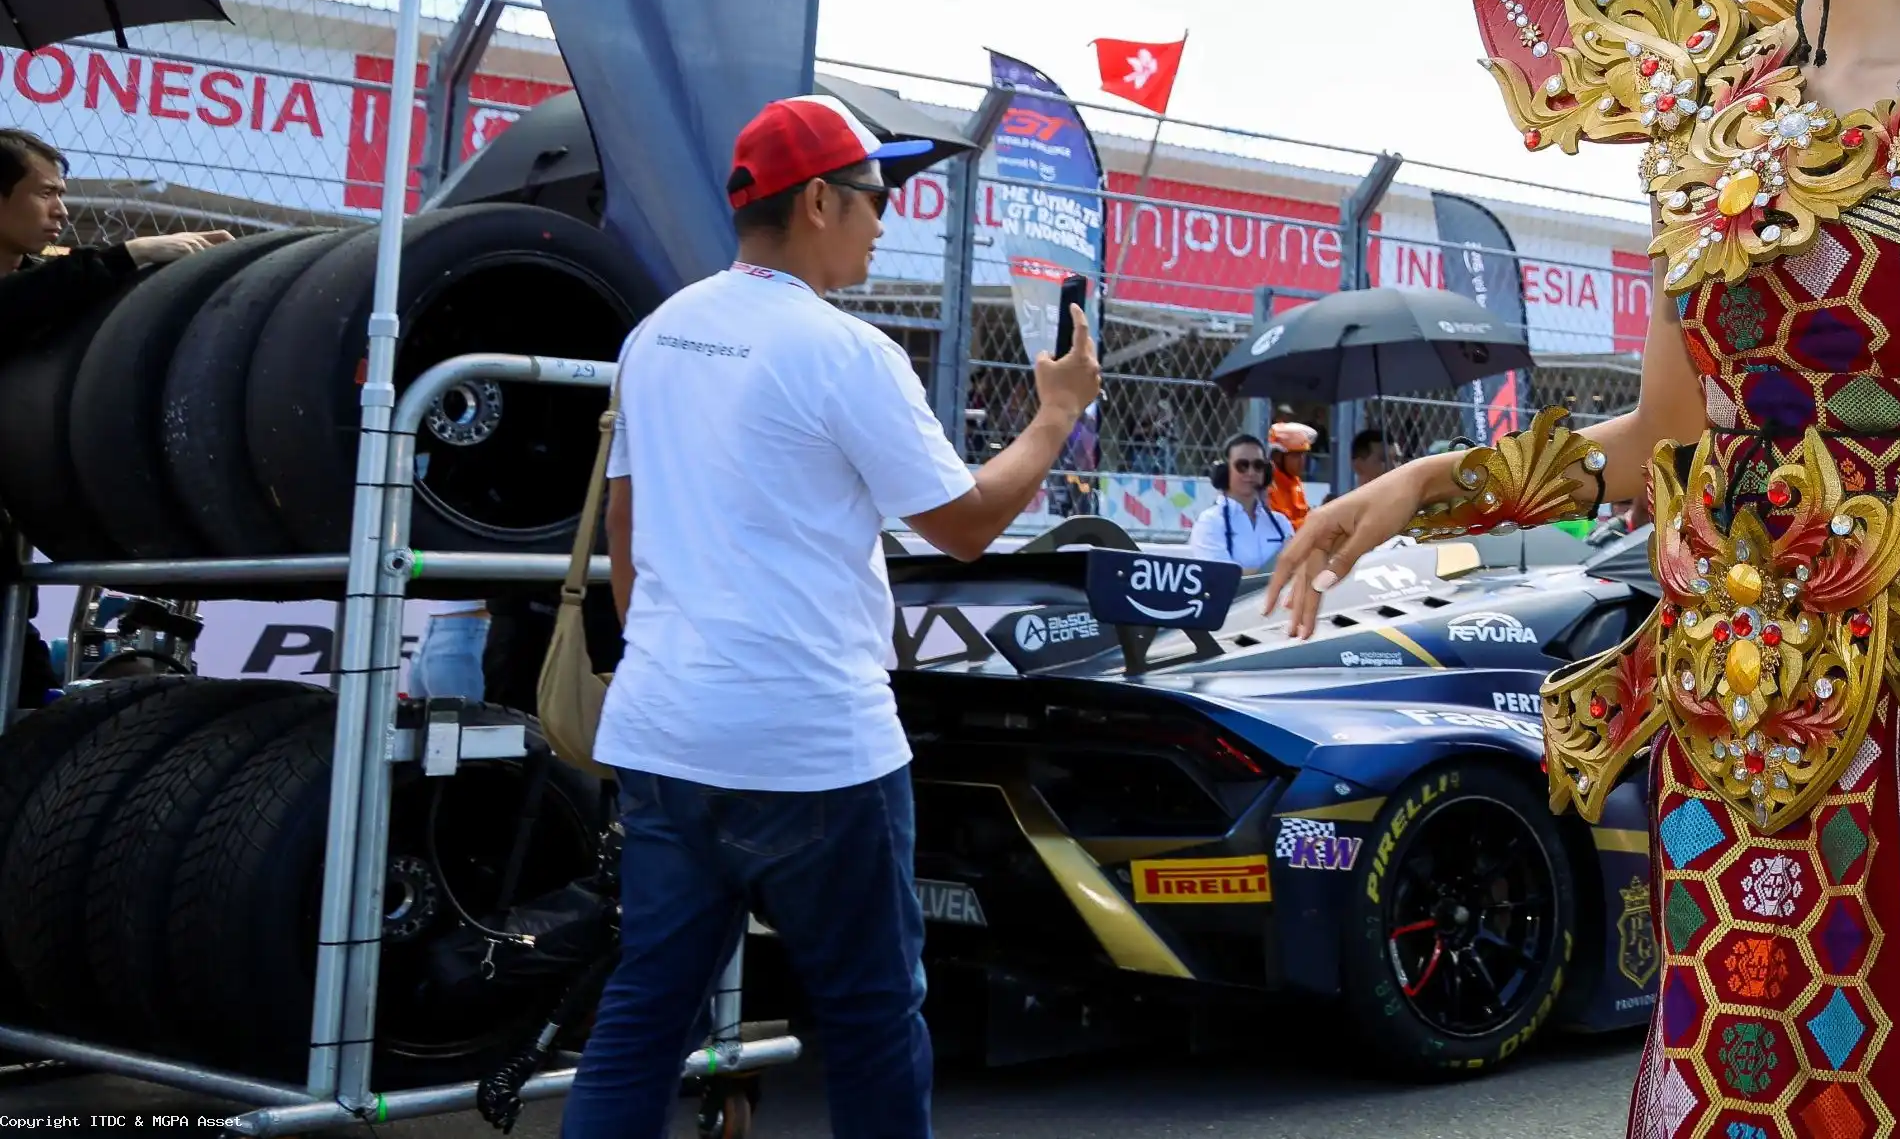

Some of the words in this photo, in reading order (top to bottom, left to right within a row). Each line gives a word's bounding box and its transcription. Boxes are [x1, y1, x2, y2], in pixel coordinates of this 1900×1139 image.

[0, 46, 323, 138] ONESIA
[1114, 202, 1371, 270] injourne
[1131, 559, 1203, 596] aws
[1288, 836, 1363, 871] KW
[1144, 864, 1268, 895] PIRELLI
